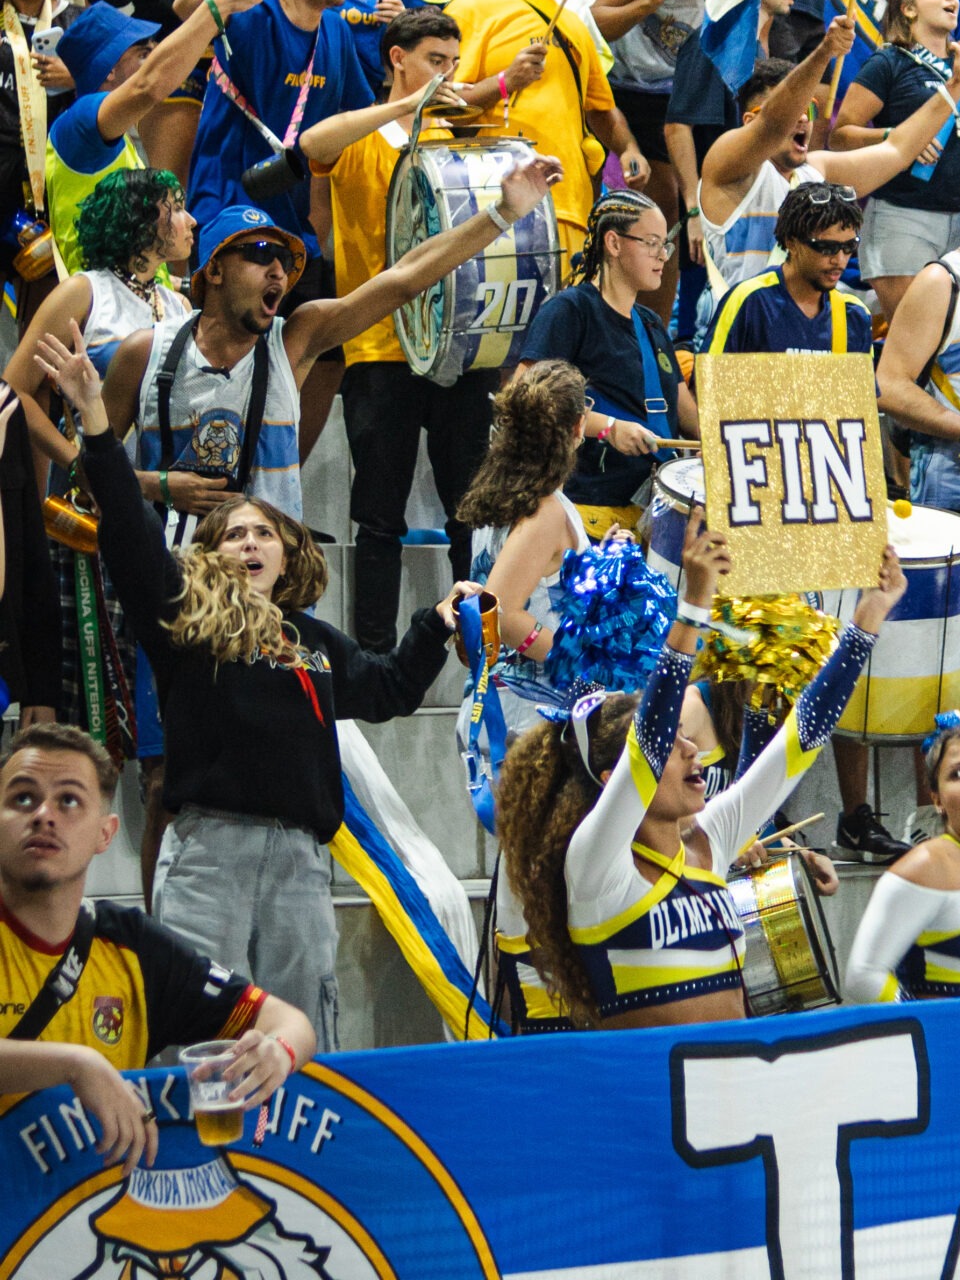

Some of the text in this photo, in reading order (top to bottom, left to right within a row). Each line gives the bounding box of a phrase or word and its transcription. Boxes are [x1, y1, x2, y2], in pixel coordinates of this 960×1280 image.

[465, 278, 538, 335] 20
[720, 418, 874, 528] FIN
[78, 553, 92, 617] DICINA
[82, 622, 95, 658] UFF
[132, 1168, 181, 1207] TORCIDA
